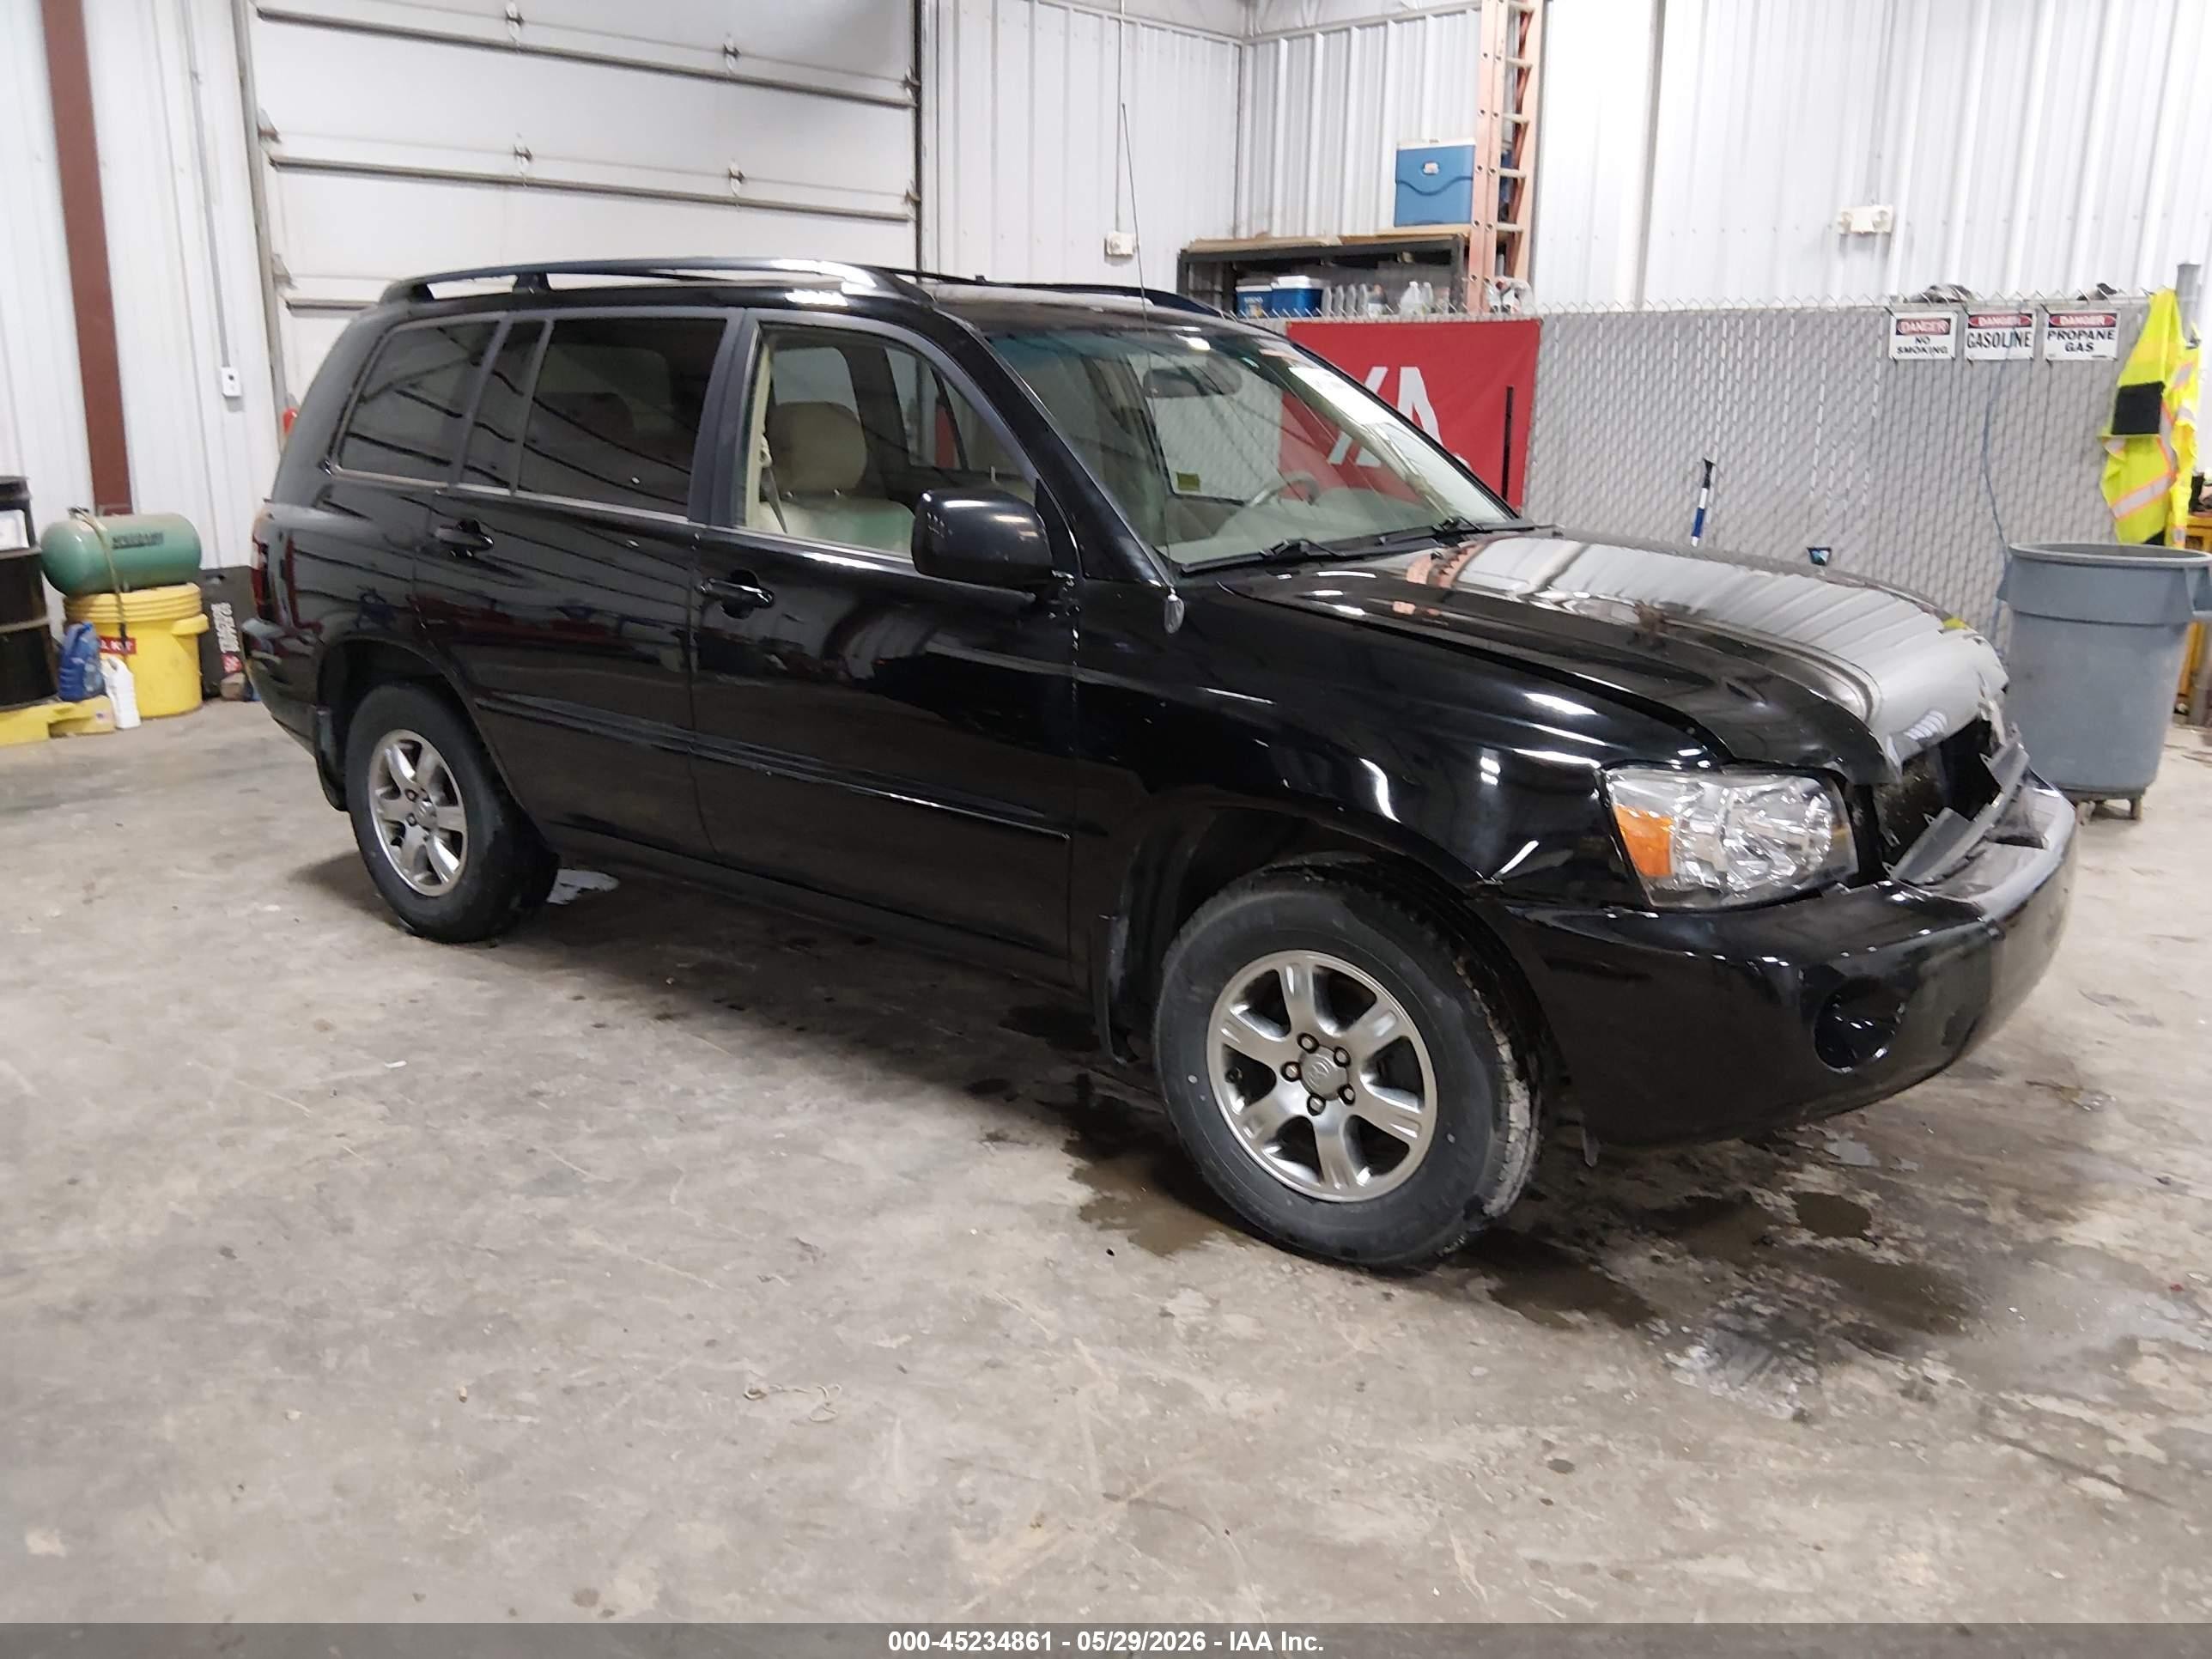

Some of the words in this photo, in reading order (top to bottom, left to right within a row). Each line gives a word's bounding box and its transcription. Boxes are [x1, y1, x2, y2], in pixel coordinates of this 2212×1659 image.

[2059, 314, 2106, 325] DANGER
[1914, 335, 1931, 344] NO
[1966, 331, 2033, 349] GASOLINE
[2046, 329, 2116, 341] PROPANE
[1896, 345, 1949, 355] SMOKING
[2064, 342, 2094, 352] GAS
